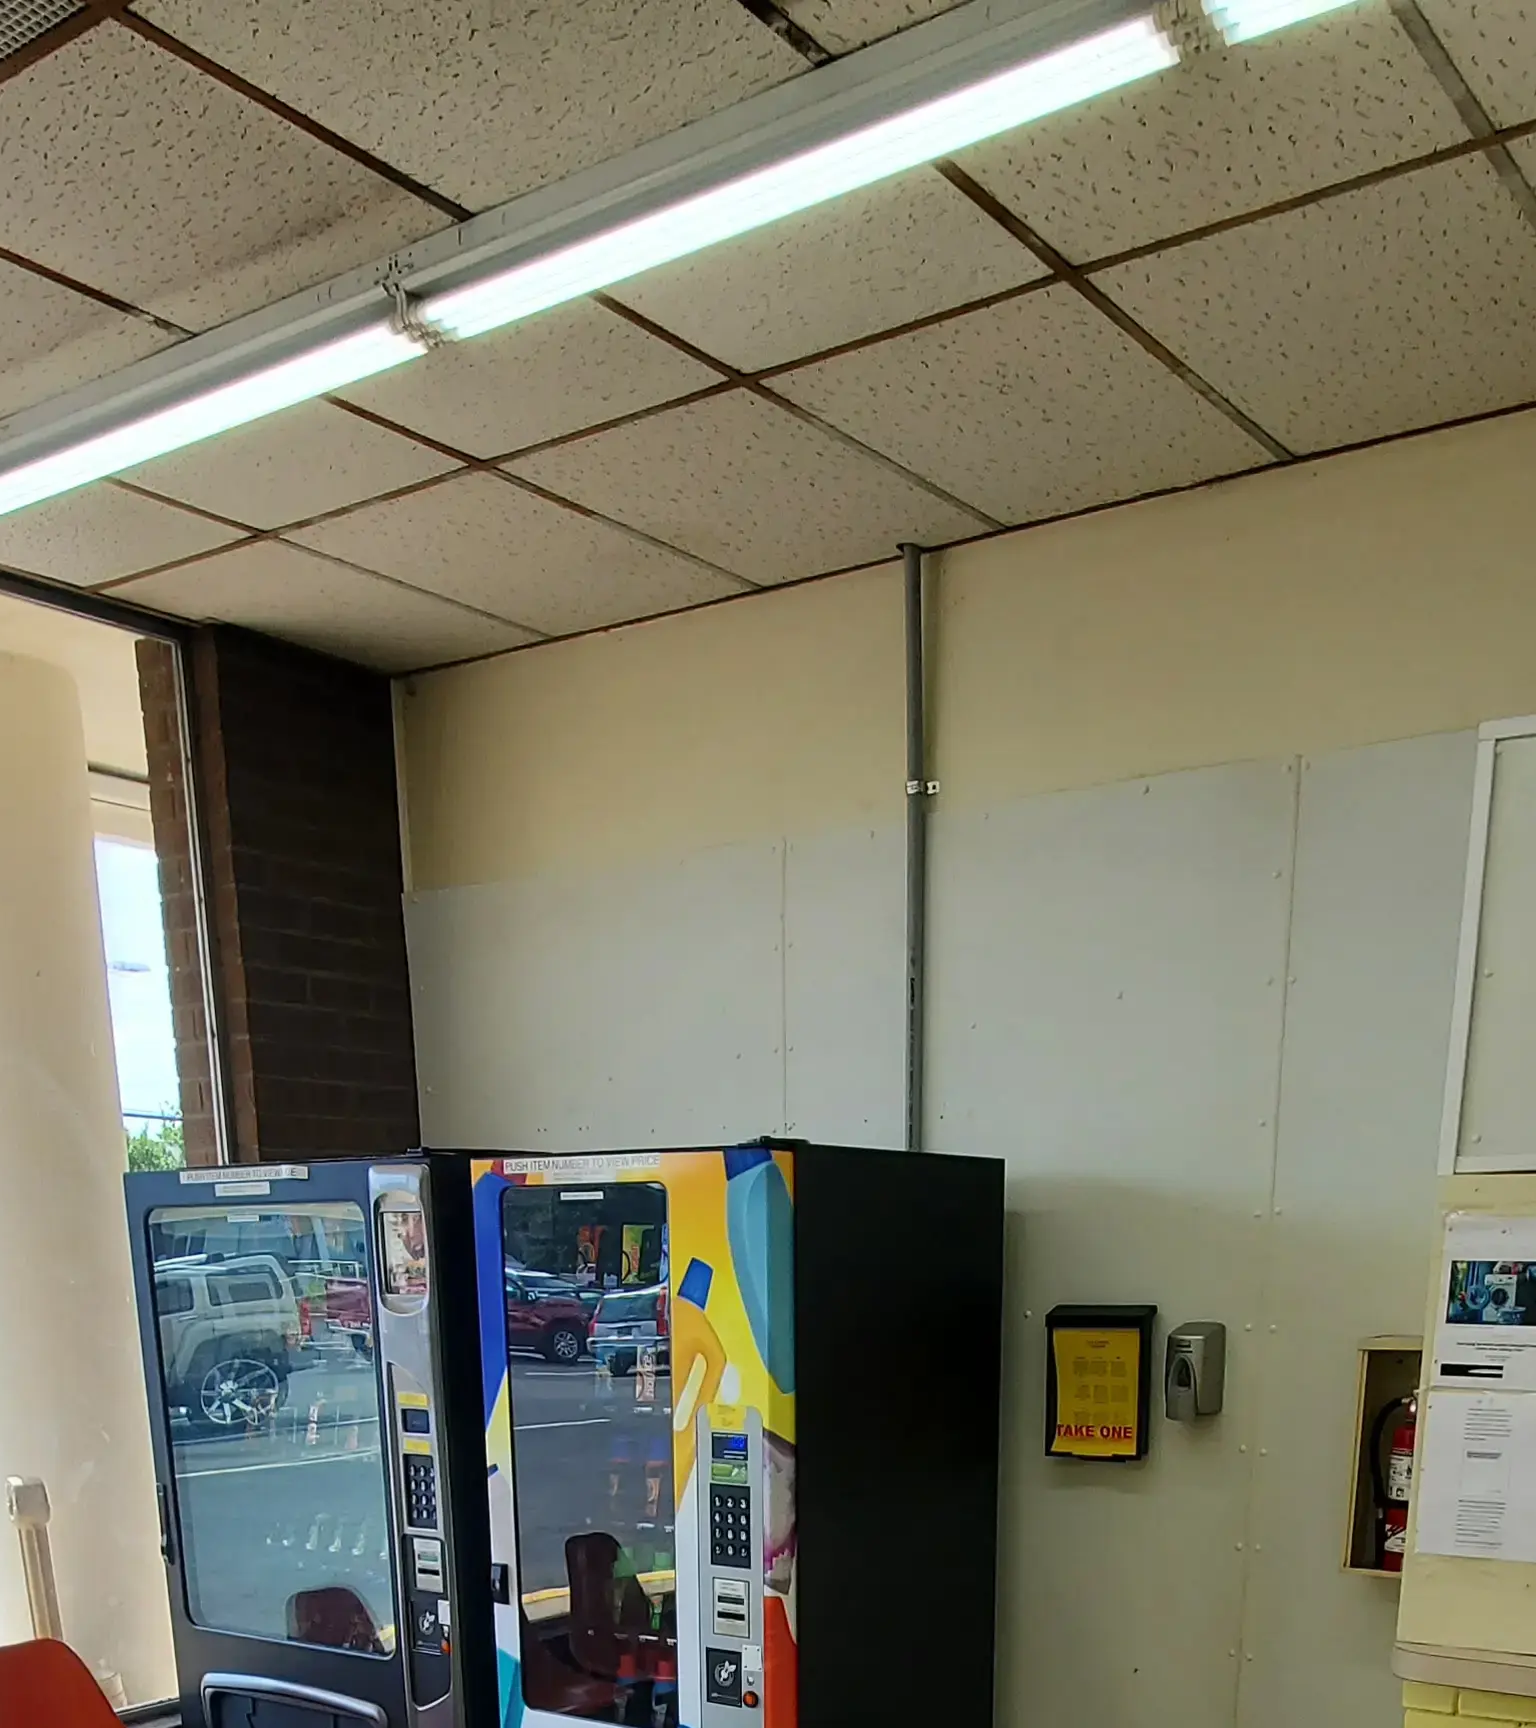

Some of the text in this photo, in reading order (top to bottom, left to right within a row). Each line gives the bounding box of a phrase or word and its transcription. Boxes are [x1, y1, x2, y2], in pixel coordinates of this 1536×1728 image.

[505, 1160, 528, 1172] PUSH
[530, 1159, 550, 1171] ITEM
[1057, 1424, 1133, 1439] TAKE ONE
